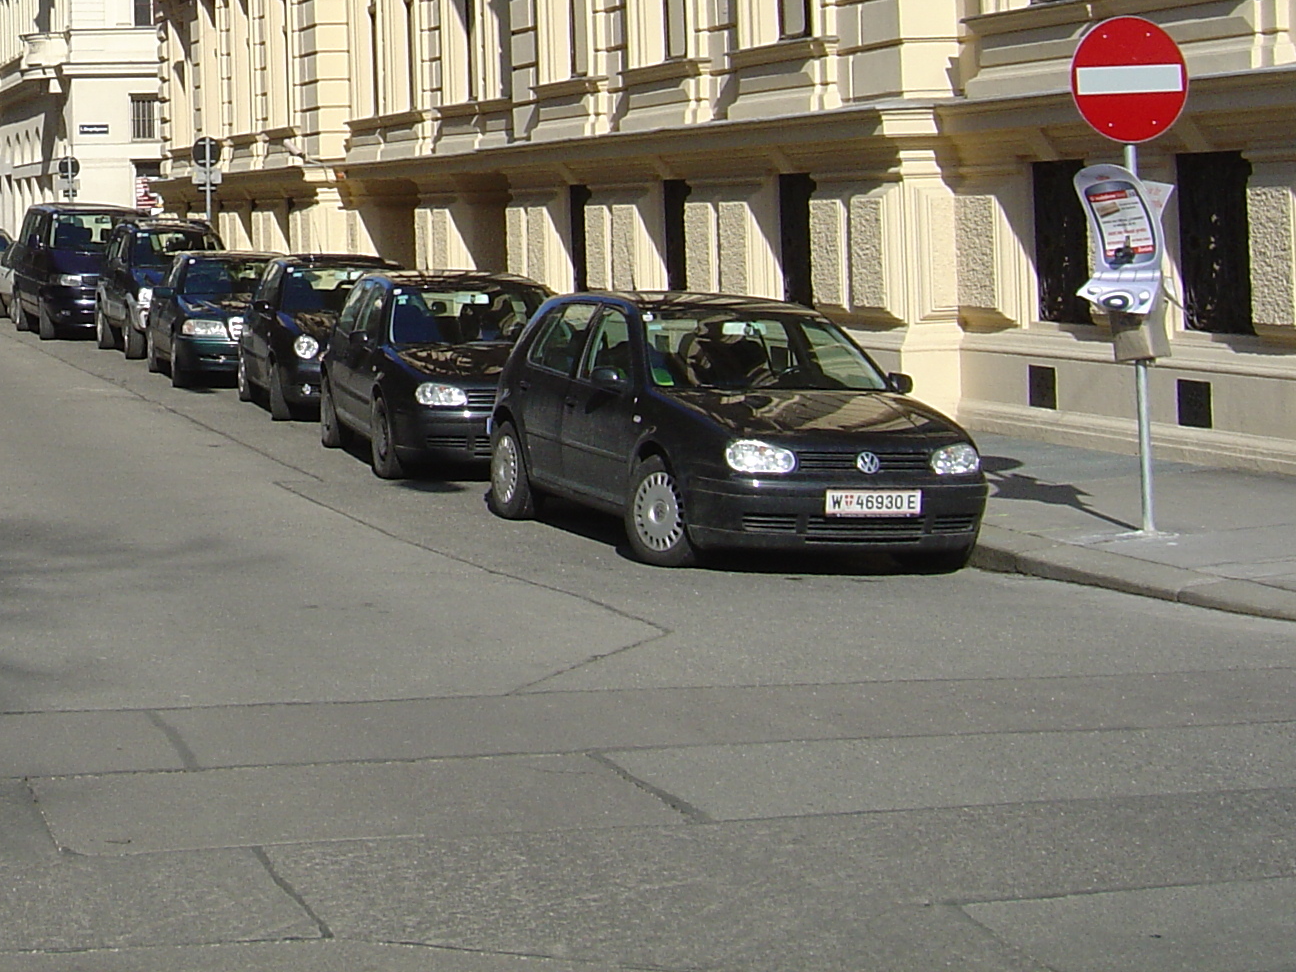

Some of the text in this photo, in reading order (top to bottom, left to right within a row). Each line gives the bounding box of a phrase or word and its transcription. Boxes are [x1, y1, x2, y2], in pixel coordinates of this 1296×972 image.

[832, 494, 916, 510] W 46930 E
